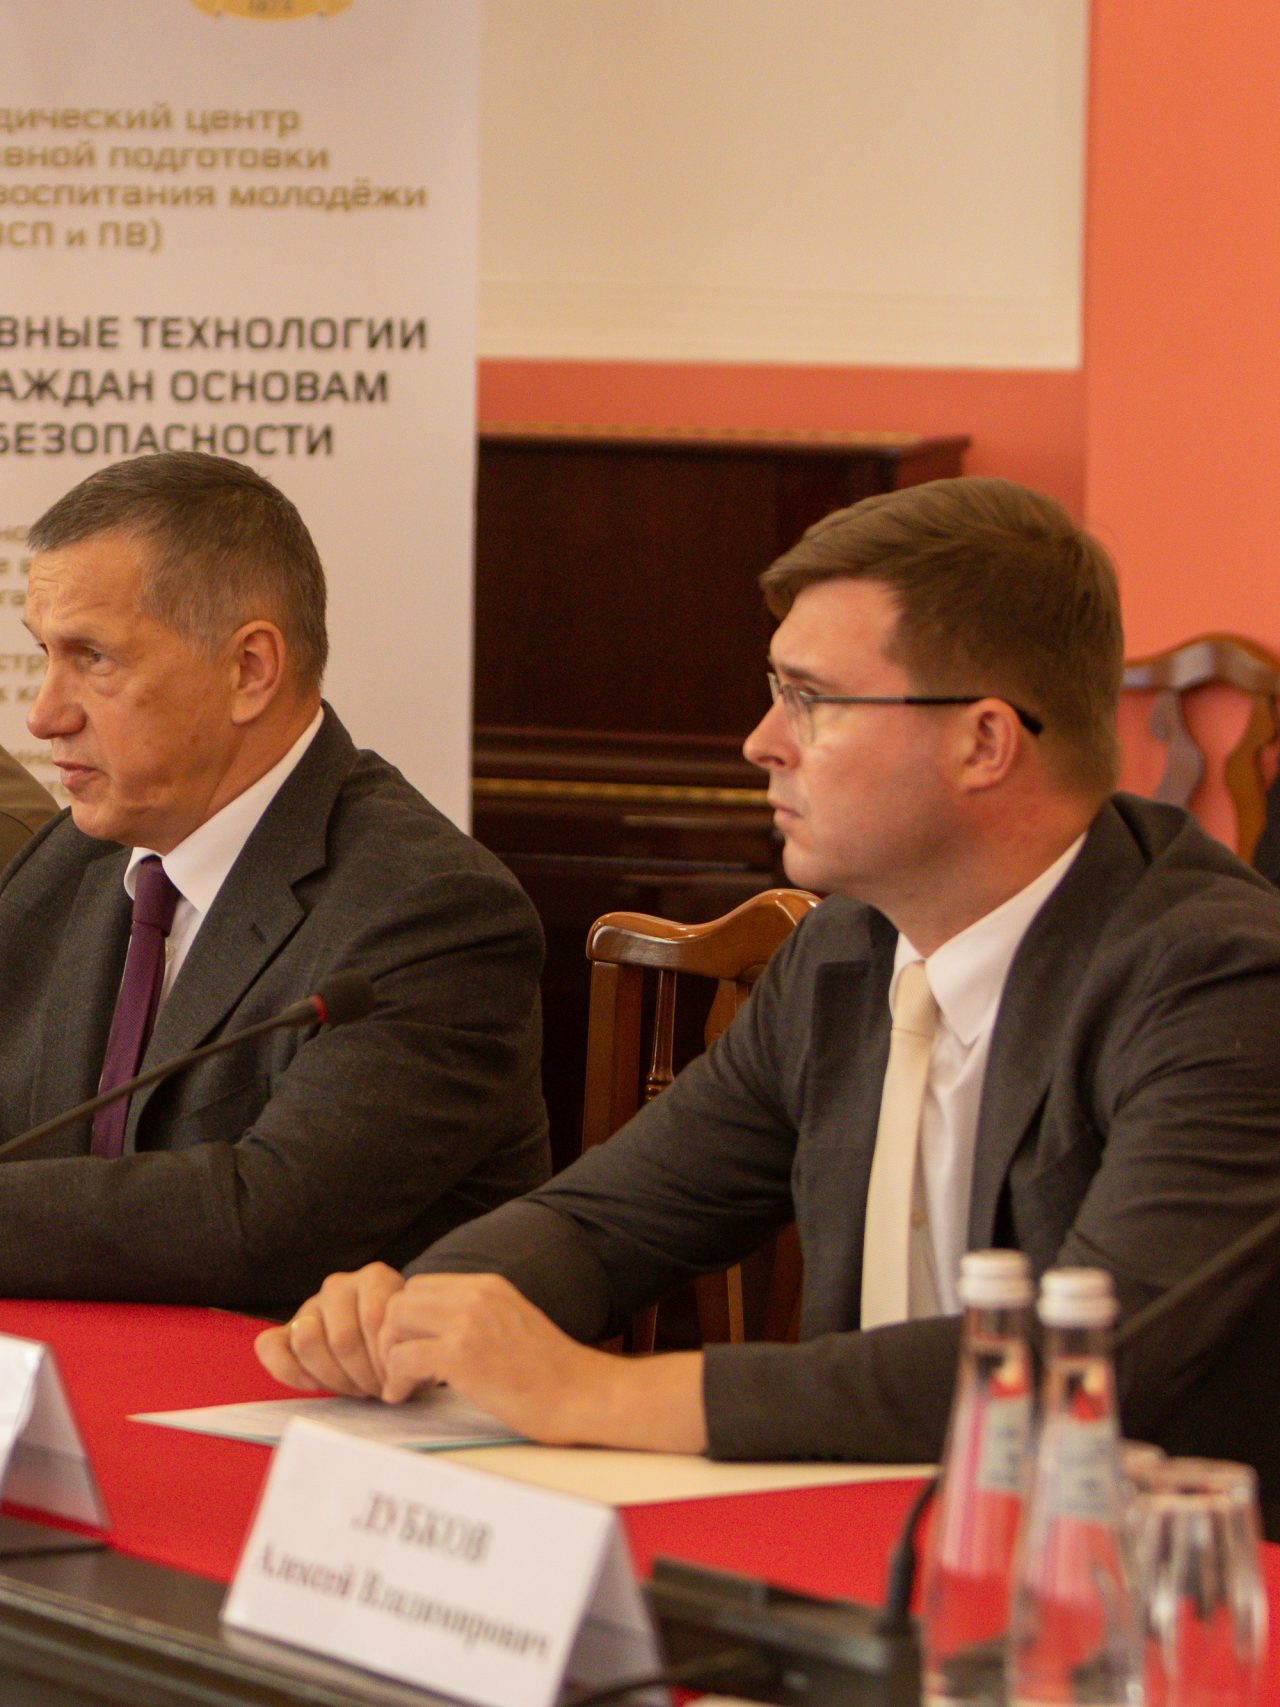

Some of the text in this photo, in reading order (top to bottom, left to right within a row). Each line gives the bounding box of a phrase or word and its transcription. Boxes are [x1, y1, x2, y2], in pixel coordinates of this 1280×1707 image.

[185, 107, 302, 139] центр
[108, 146, 330, 175] подготовки
[228, 178, 428, 213] молодёжи
[65, 228, 88, 248] и
[98, 218, 163, 253] ПВ)
[134, 315, 428, 352] ТЕХНОЛОГИИ
[169, 370, 389, 405] ОСНОВАМ
